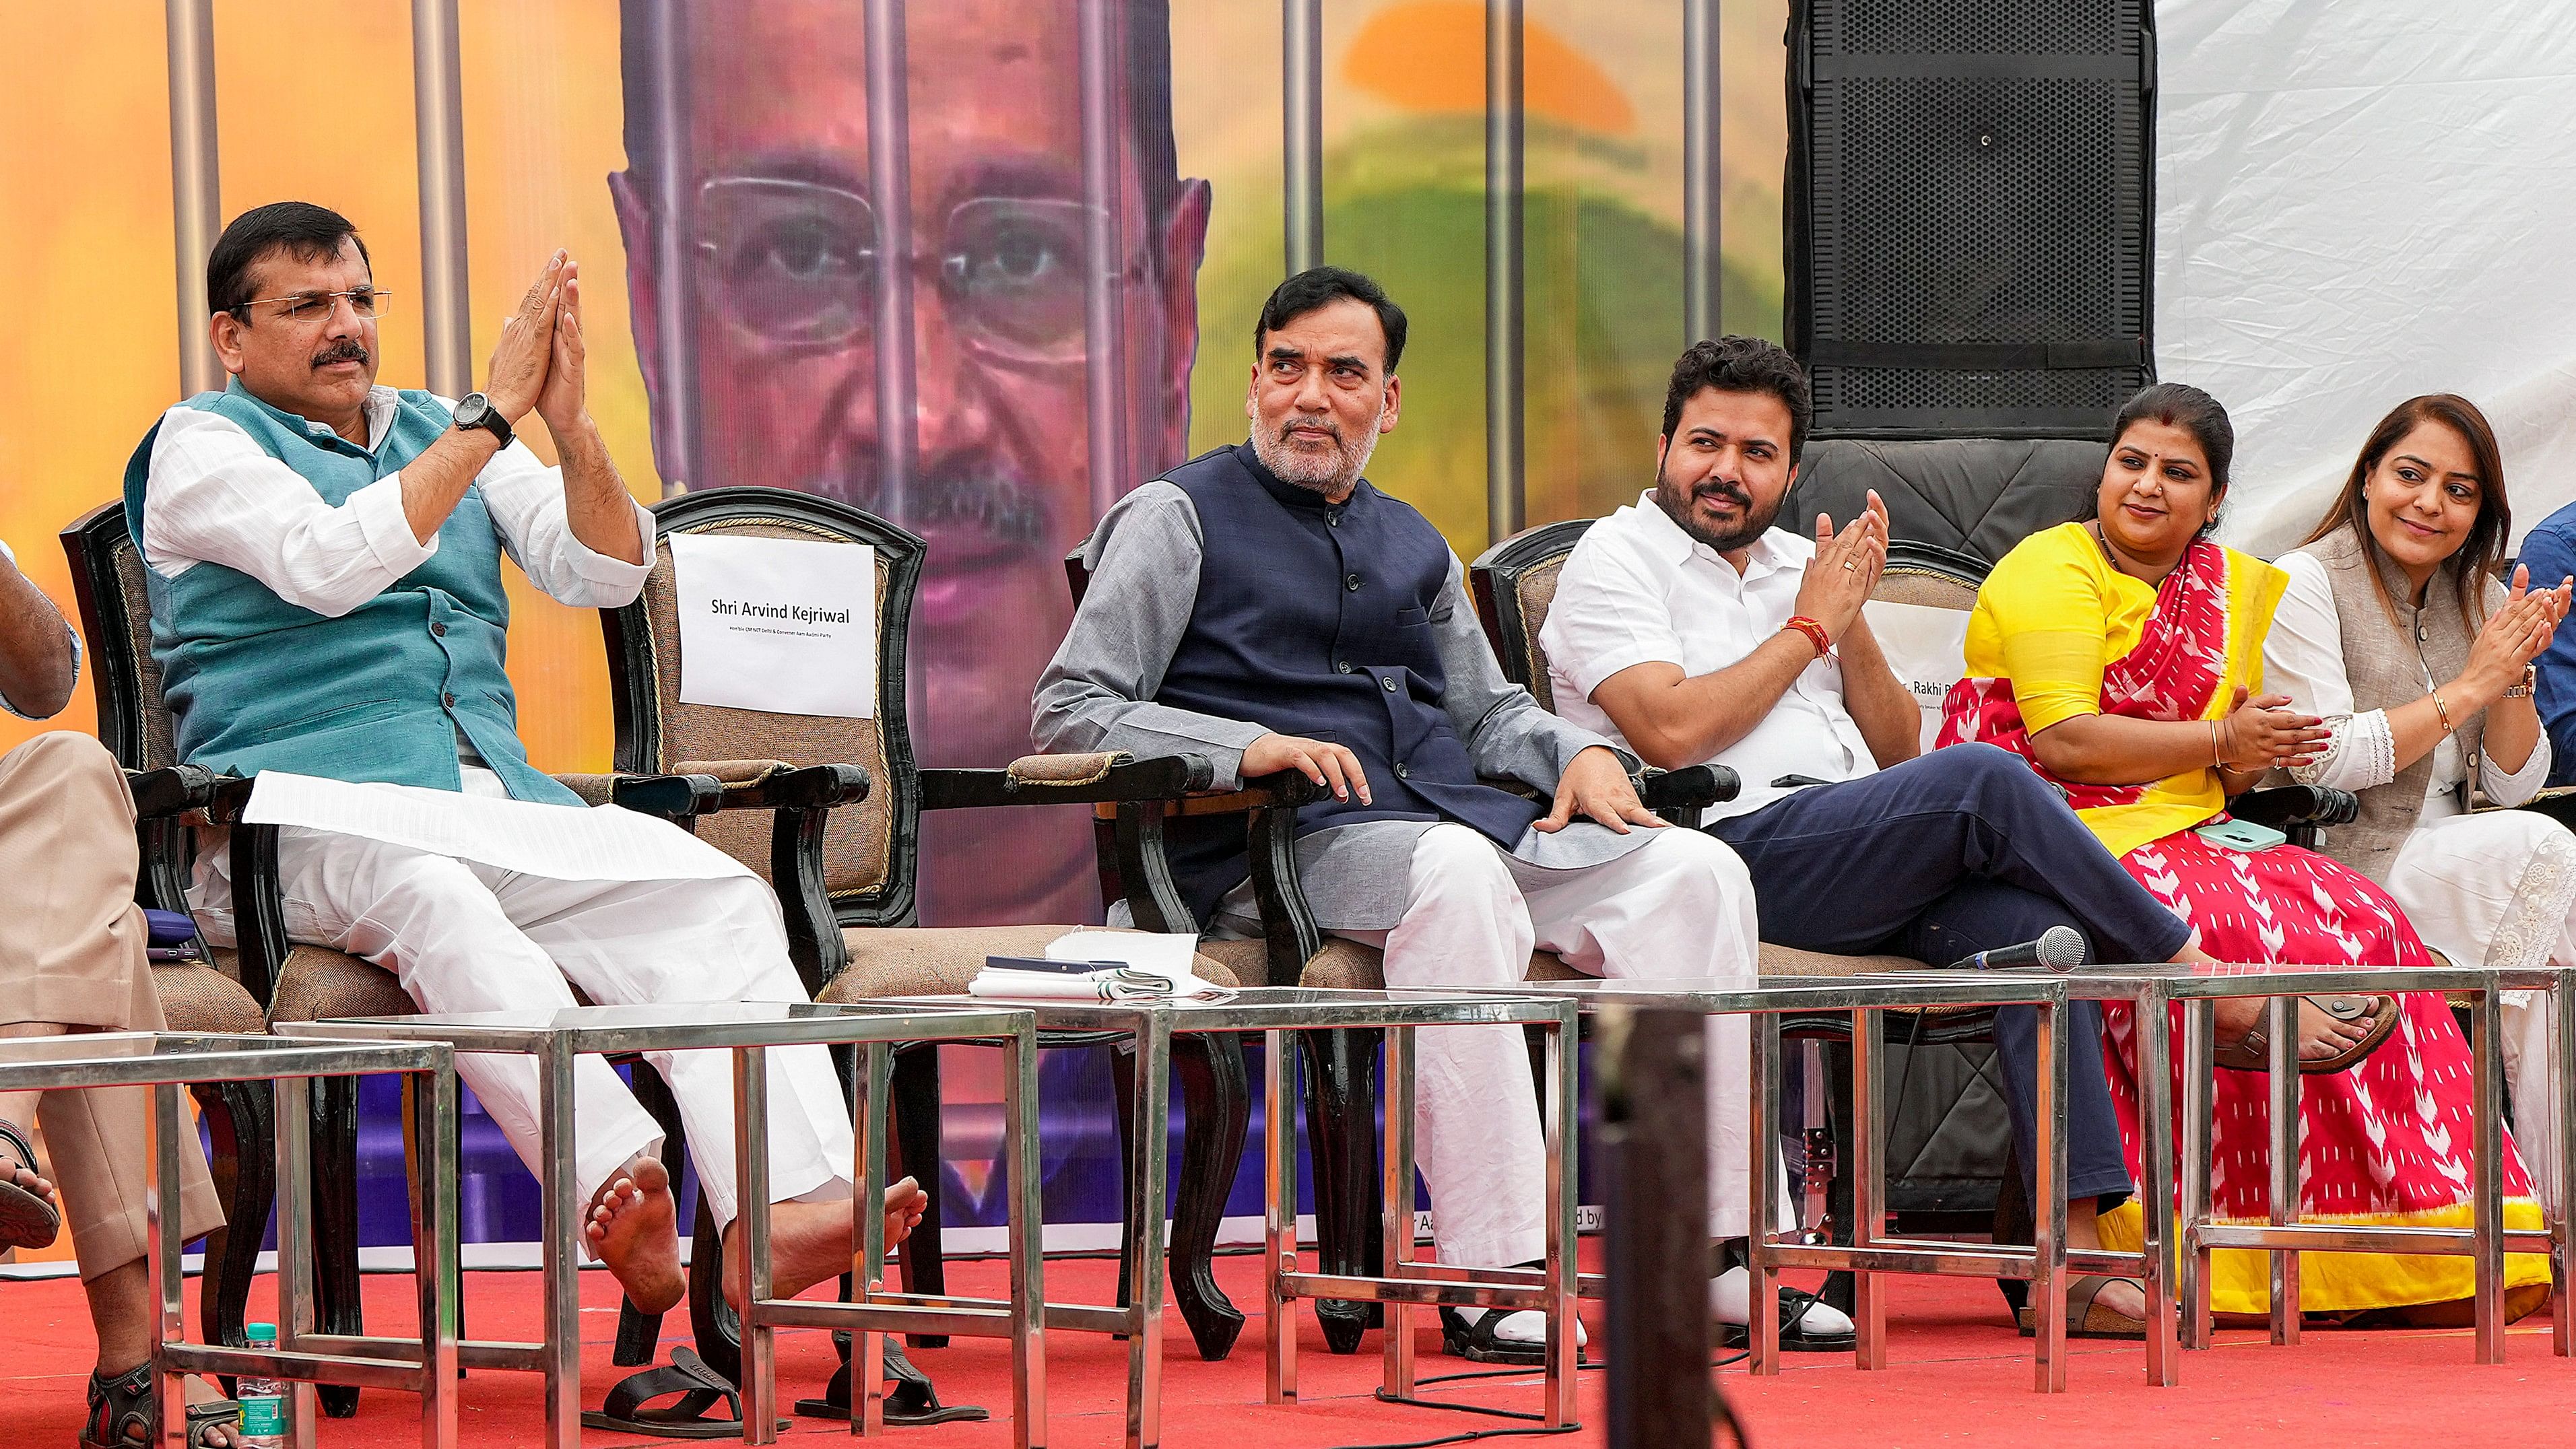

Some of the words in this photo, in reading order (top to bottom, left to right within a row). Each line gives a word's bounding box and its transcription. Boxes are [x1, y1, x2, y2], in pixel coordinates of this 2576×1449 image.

[712, 599, 737, 615] Shri
[741, 602, 787, 619] Arvind
[792, 605, 850, 624] Kejriwal
[1914, 681, 1941, 696] Rakhi
[1587, 1209, 1601, 1229] by
